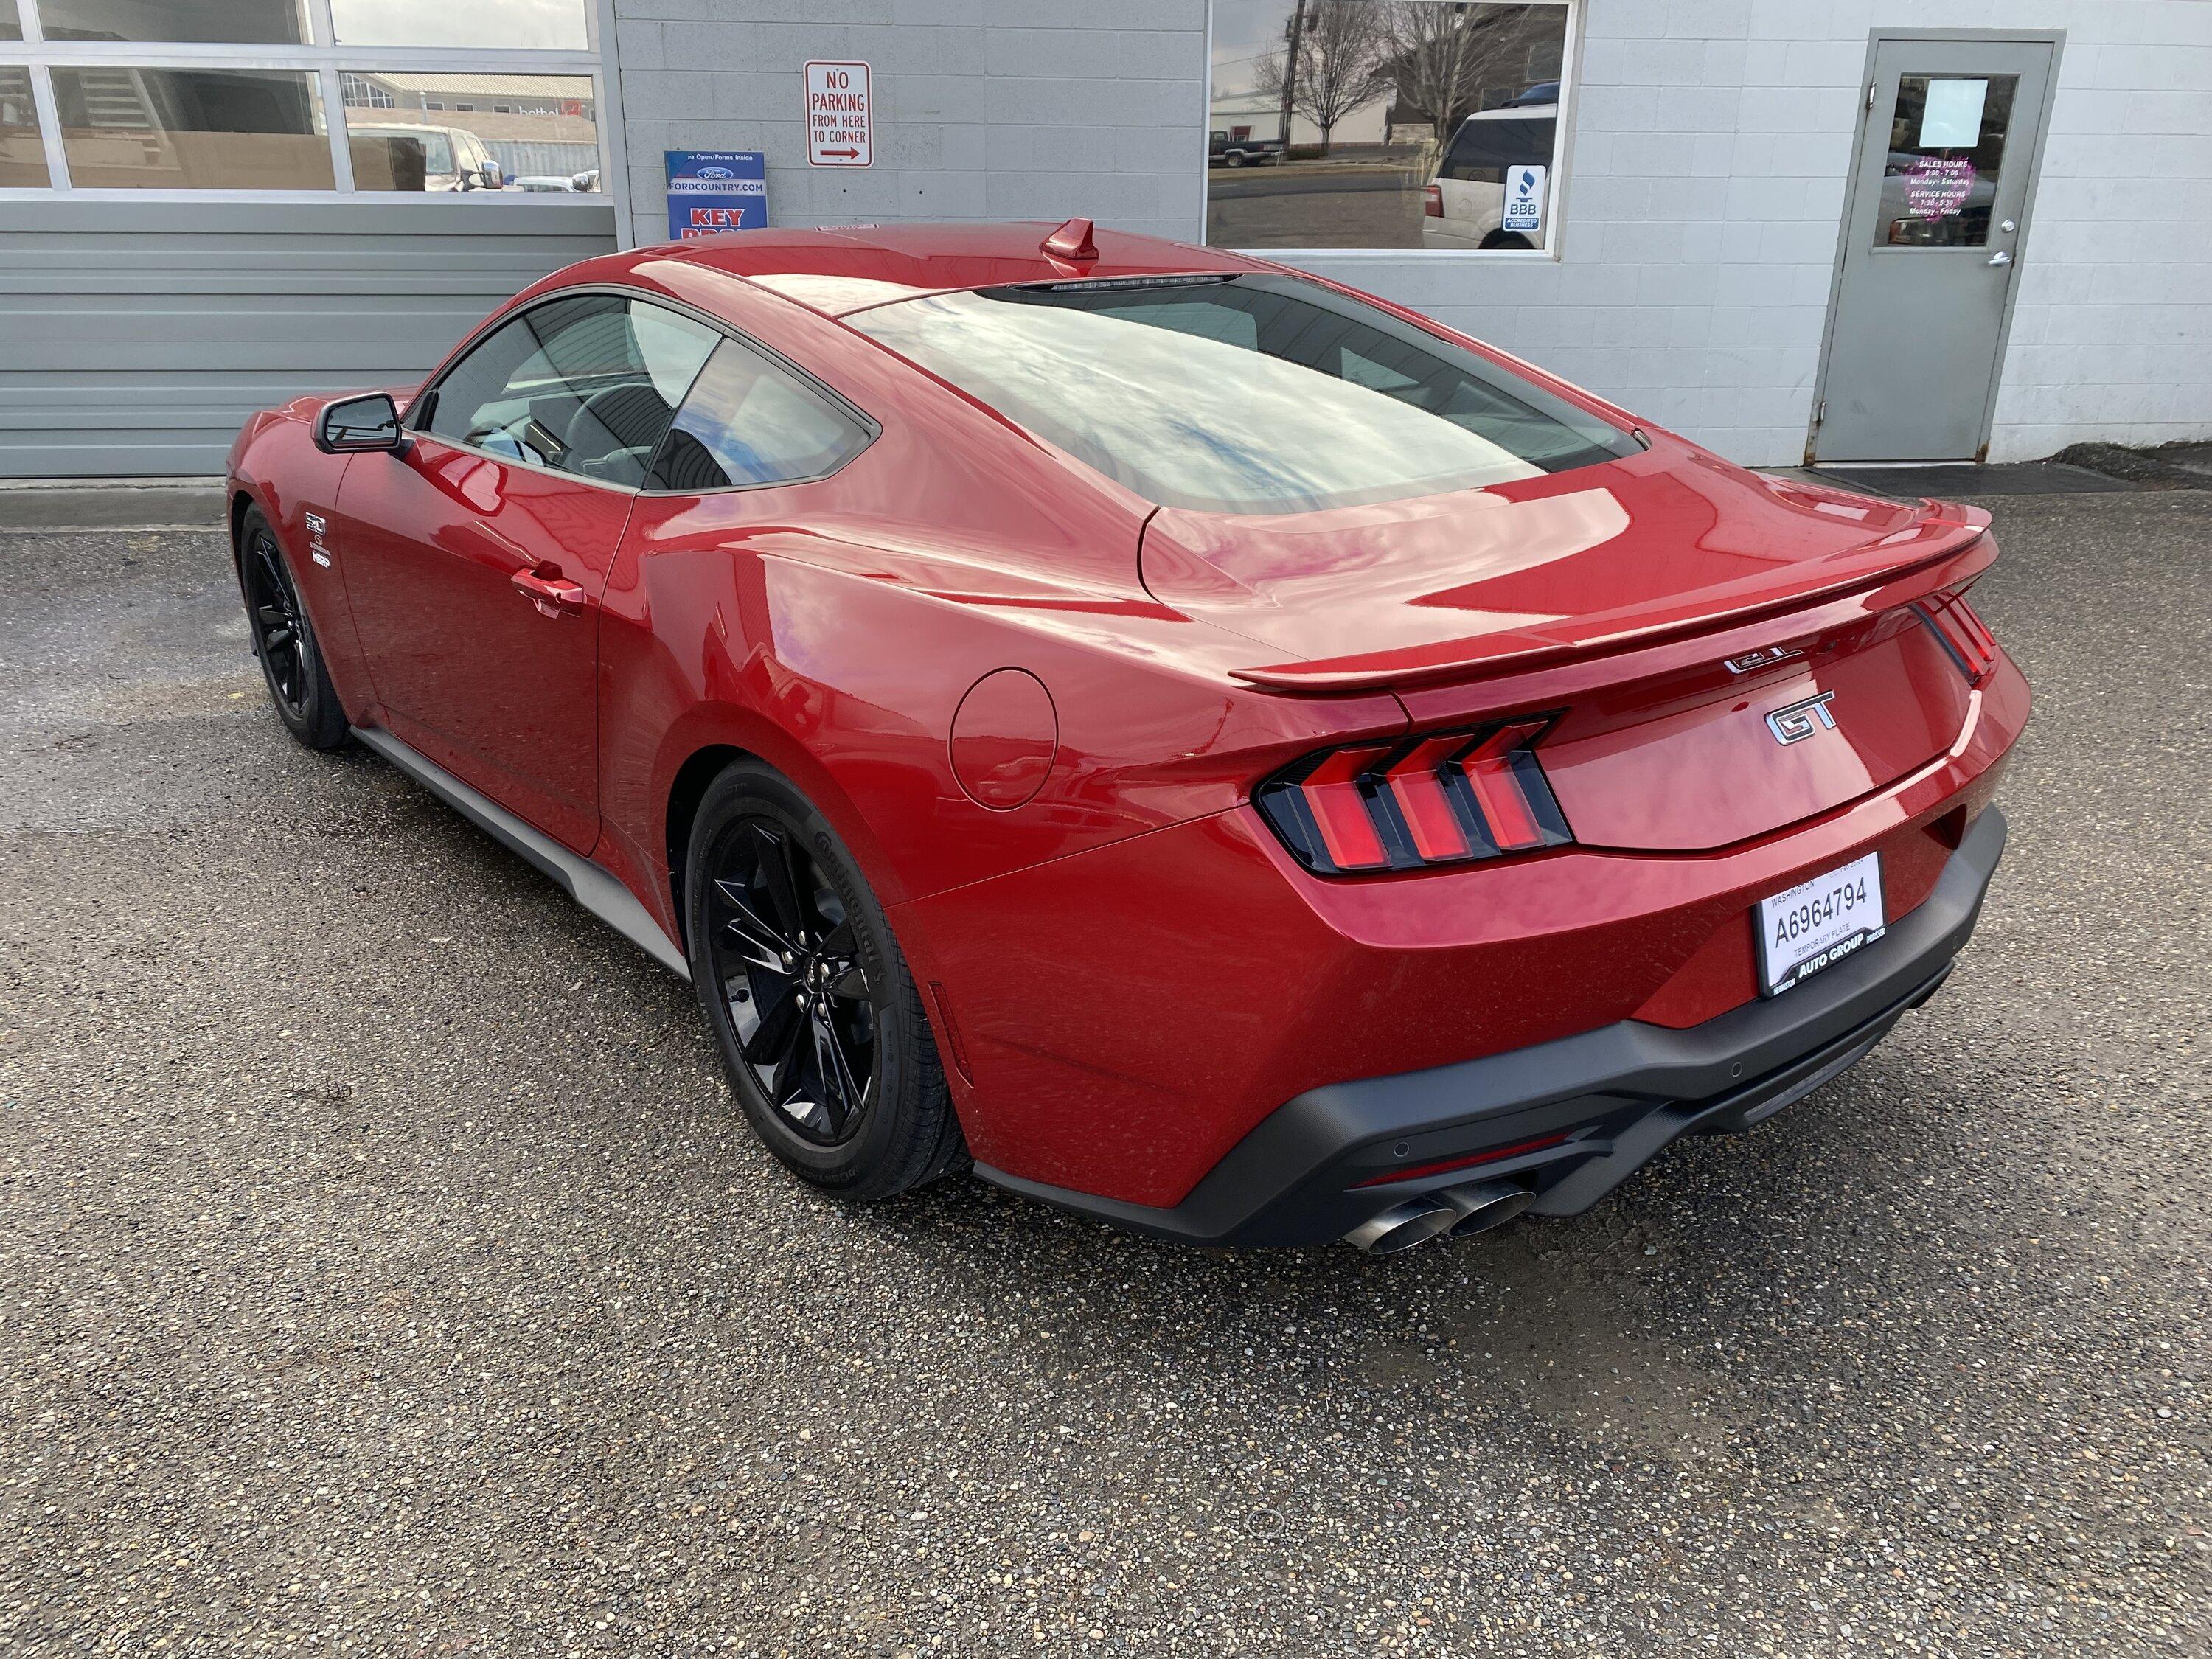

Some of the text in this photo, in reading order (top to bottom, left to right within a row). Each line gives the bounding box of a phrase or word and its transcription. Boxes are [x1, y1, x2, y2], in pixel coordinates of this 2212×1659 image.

[826, 71, 849, 89] NO
[812, 93, 865, 111] PARKING
[813, 114, 866, 128] FROM HERE
[814, 130, 866, 144] TO CORNER
[696, 153, 733, 161] Open/Forms
[703, 168, 727, 179] Ford
[669, 182, 763, 192] FORDCOUNTRY.COM
[1910, 178, 1935, 186] Monday
[1941, 178, 1969, 186] Saturday
[690, 208, 745, 227] KEY
[1510, 204, 1537, 215] BBB
[1764, 690, 1836, 746] GT
[1775, 877, 1868, 949] A6964794
[1794, 922, 1851, 958] TEMPORARY PLATE
[1798, 933, 1864, 978] AUTO GROUP
